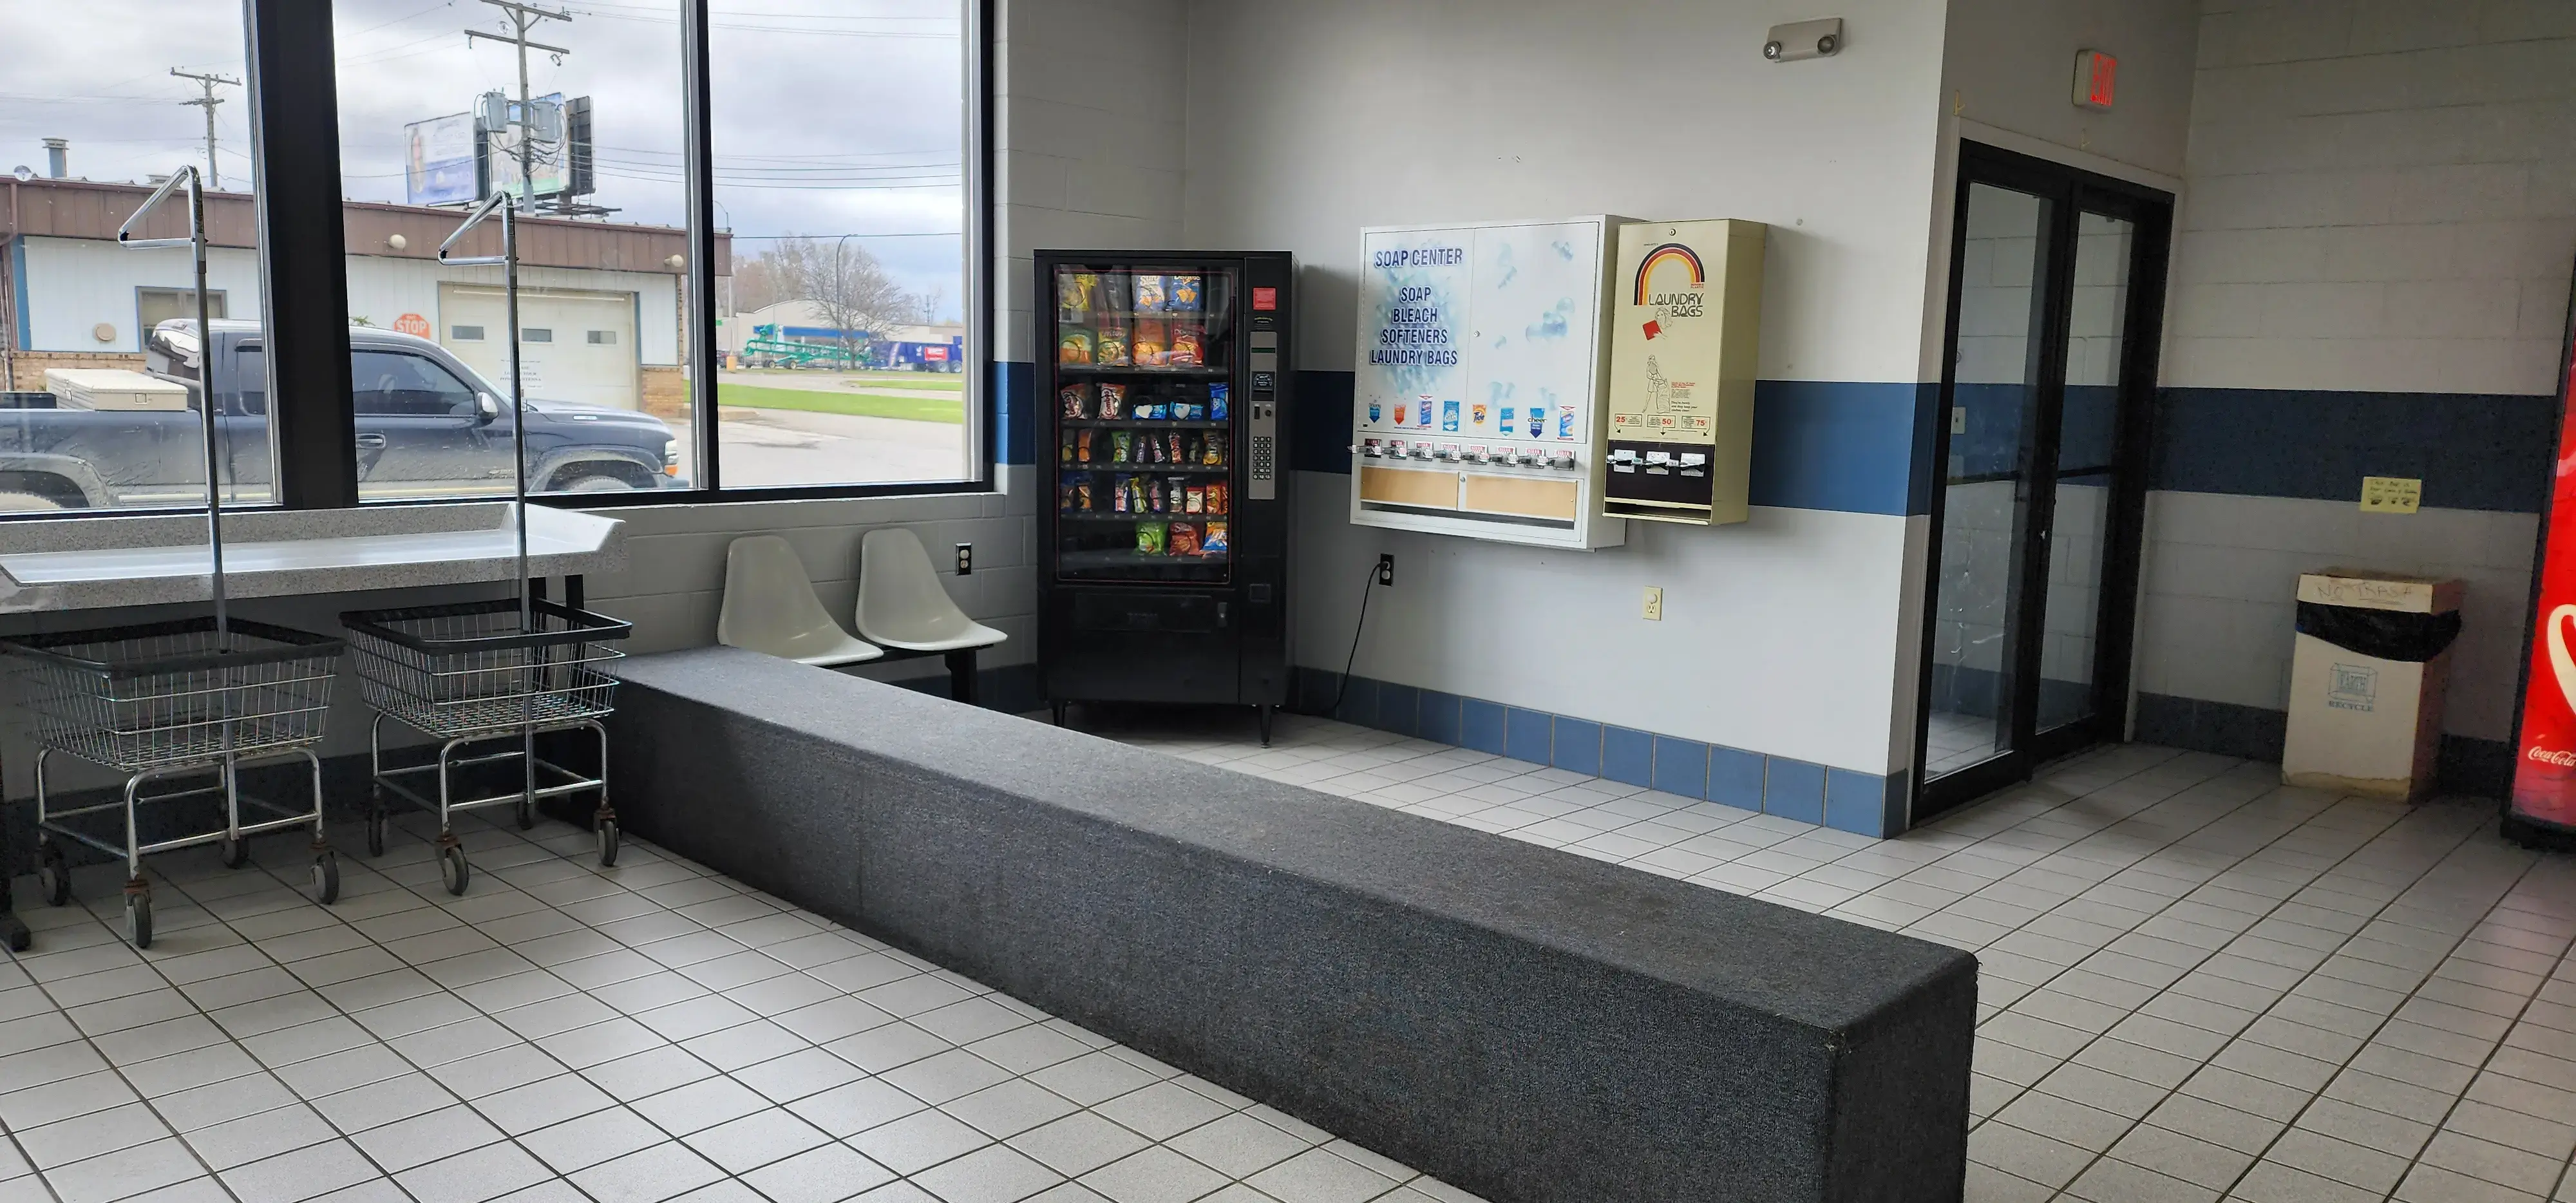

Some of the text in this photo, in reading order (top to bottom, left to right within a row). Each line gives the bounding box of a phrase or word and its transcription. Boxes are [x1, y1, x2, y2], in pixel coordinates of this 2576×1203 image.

[2091, 53, 2116, 107] EXIT
[1375, 247, 1463, 267] SOAP CENTER
[1400, 287, 1432, 302] SOAP
[1649, 292, 1705, 306] LAUNDRY
[1392, 307, 1438, 323] BLEACH
[1671, 305, 1703, 317] BAGS
[395, 319, 426, 334] STOP
[1381, 328, 1448, 345] SOFTENERS
[1370, 349, 1458, 366] LAUNDRY BAGS
[1473, 411, 1485, 423] Tide
[1528, 414, 1547, 423] cheer
